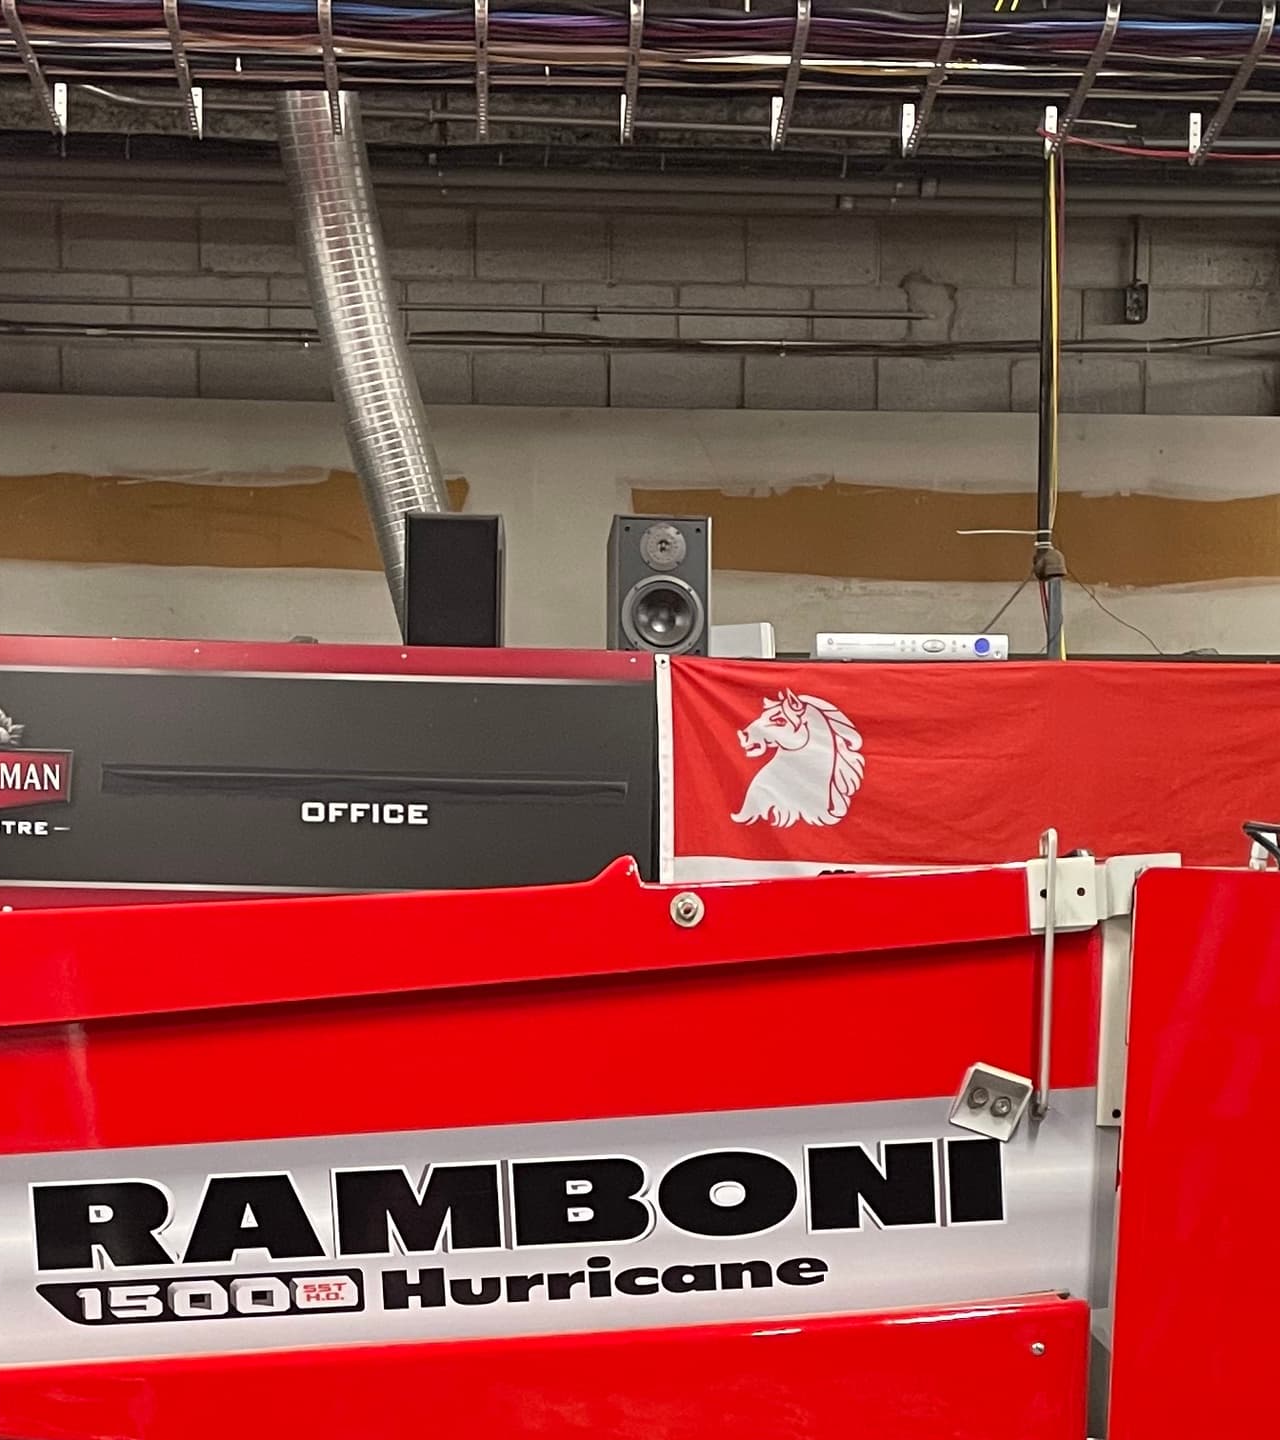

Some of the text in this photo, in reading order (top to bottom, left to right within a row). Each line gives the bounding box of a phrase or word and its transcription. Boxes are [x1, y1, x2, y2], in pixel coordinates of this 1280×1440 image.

[300, 801, 430, 825] OFFICE
[28, 1136, 1007, 1272] RAMBONI
[73, 1254, 830, 1323] 1500 Hurricane
[303, 1282, 348, 1293] SST
